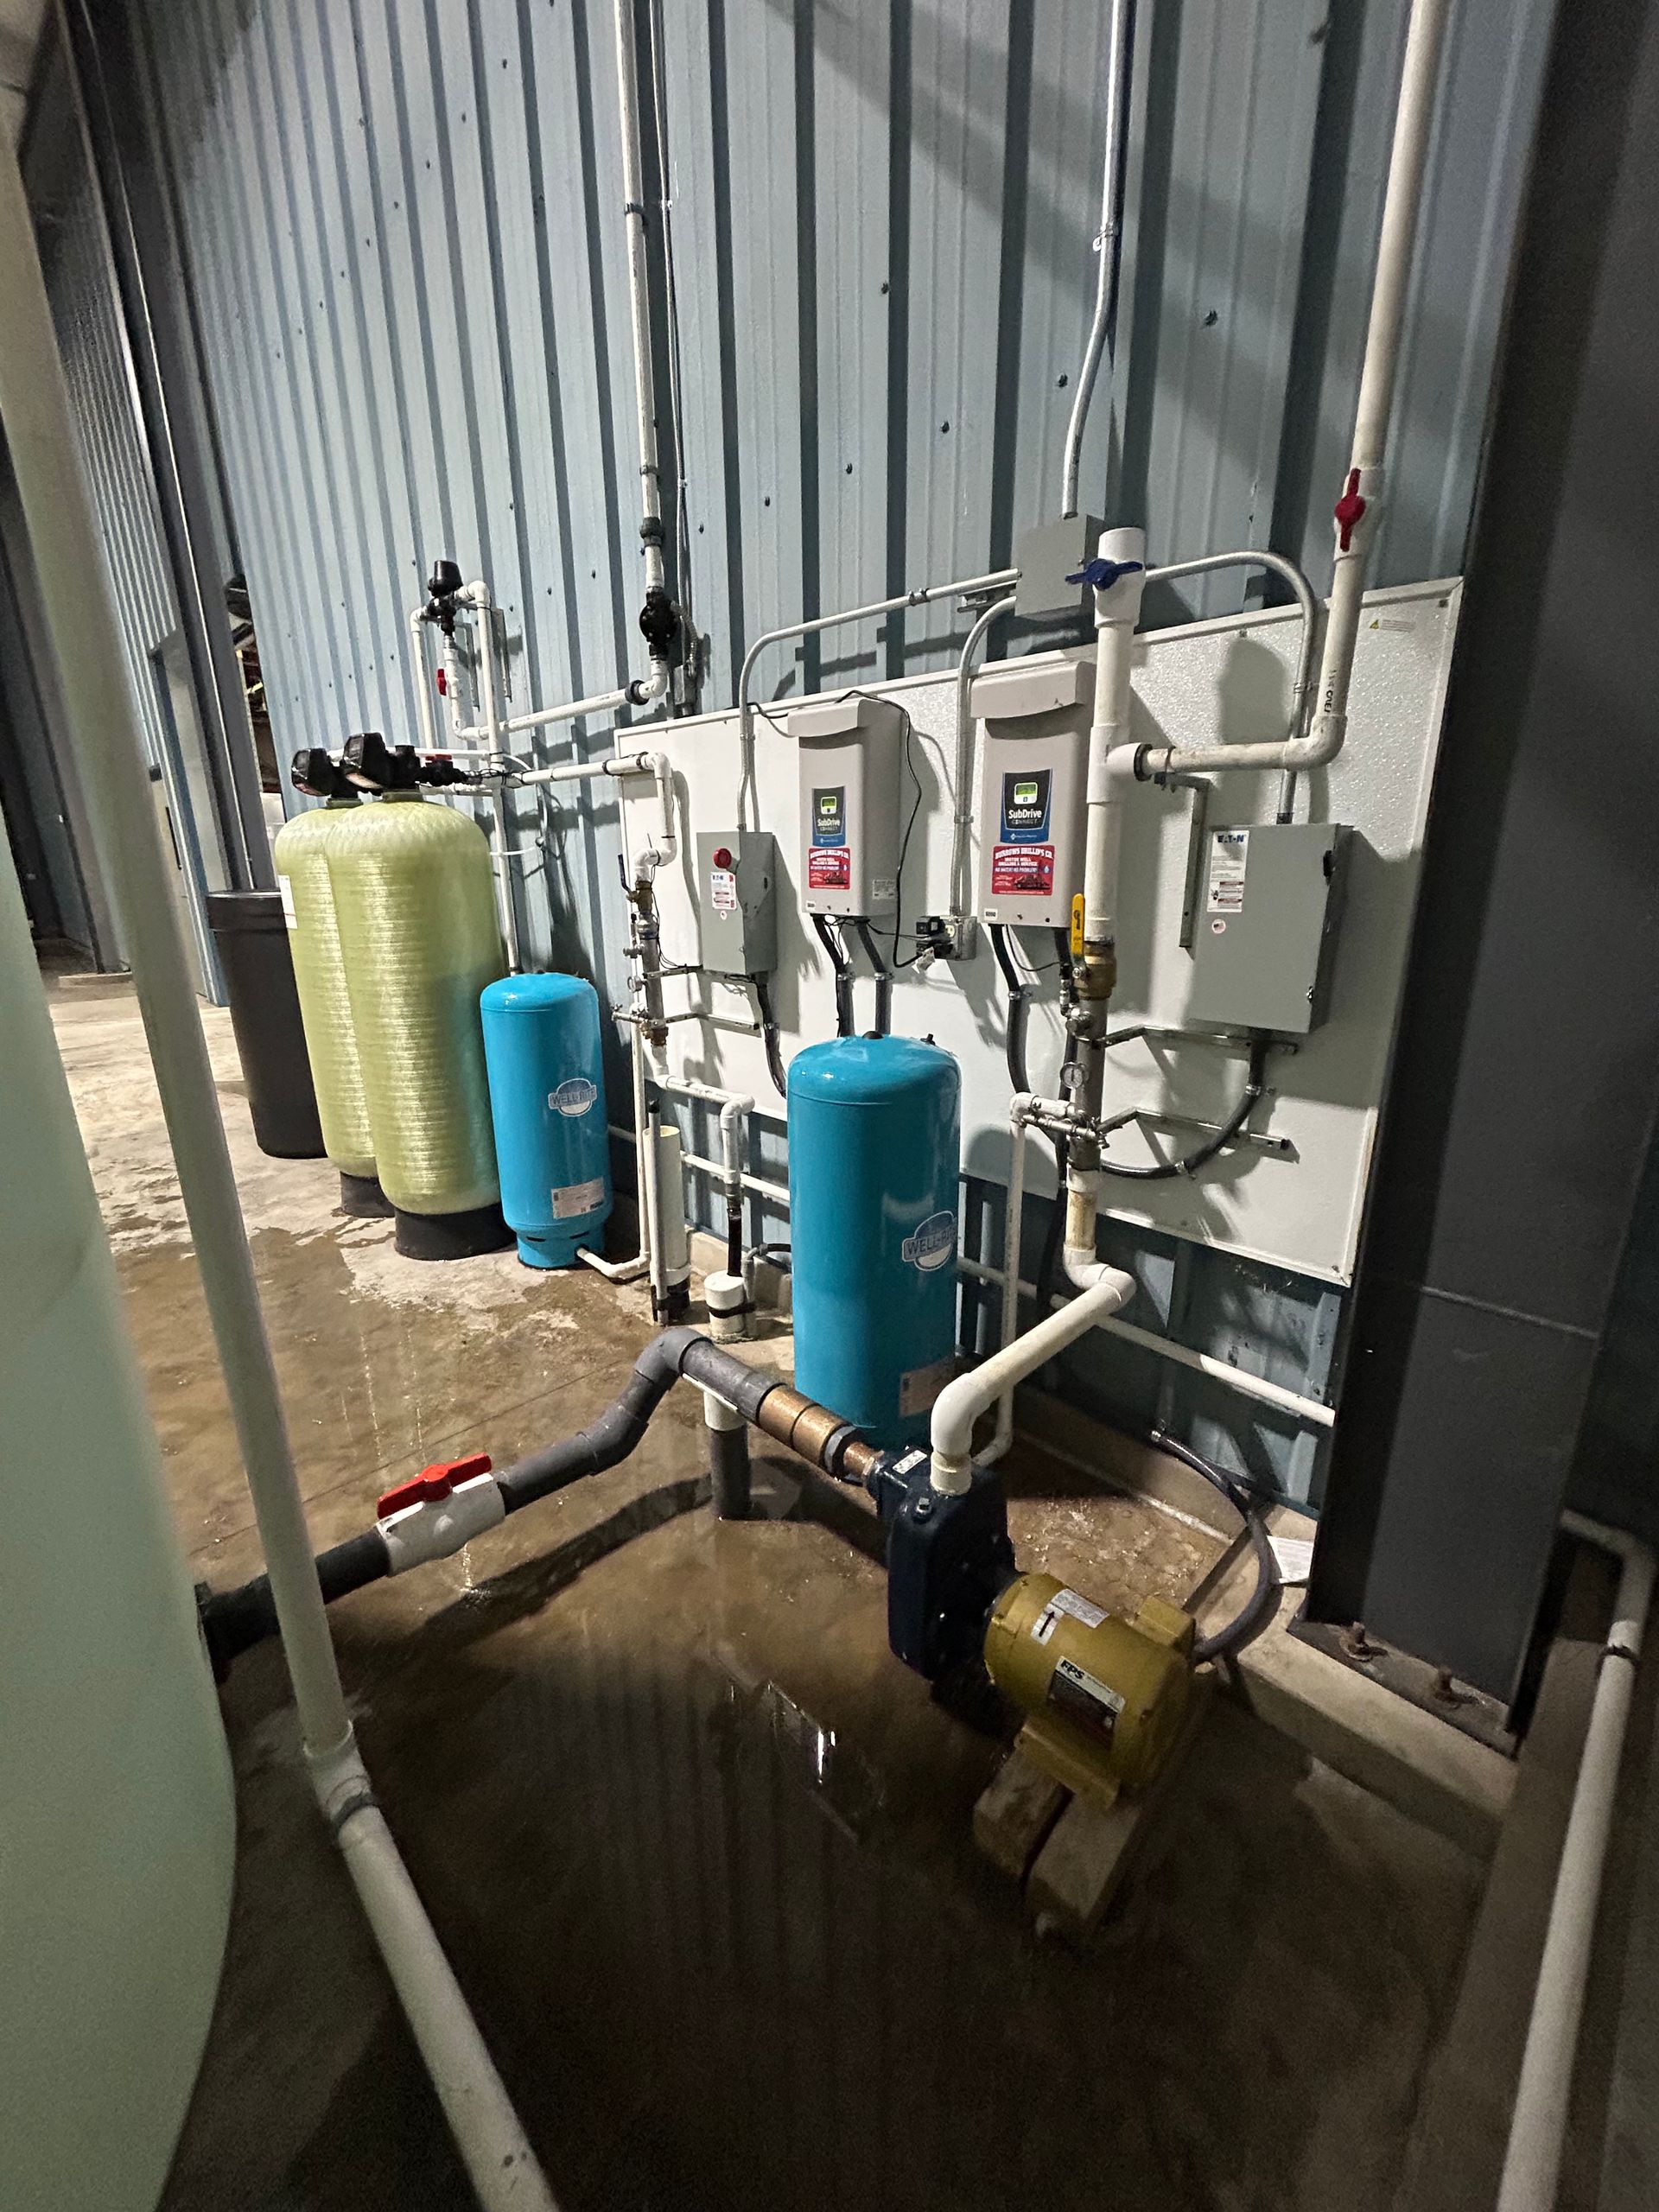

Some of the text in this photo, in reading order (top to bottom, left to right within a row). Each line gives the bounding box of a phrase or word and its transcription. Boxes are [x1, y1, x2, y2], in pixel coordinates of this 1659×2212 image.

[1008, 809, 1042, 819] SubDrive
[817, 818, 841, 827] SubDrive
[1060, 1659, 1085, 1680] FPS
